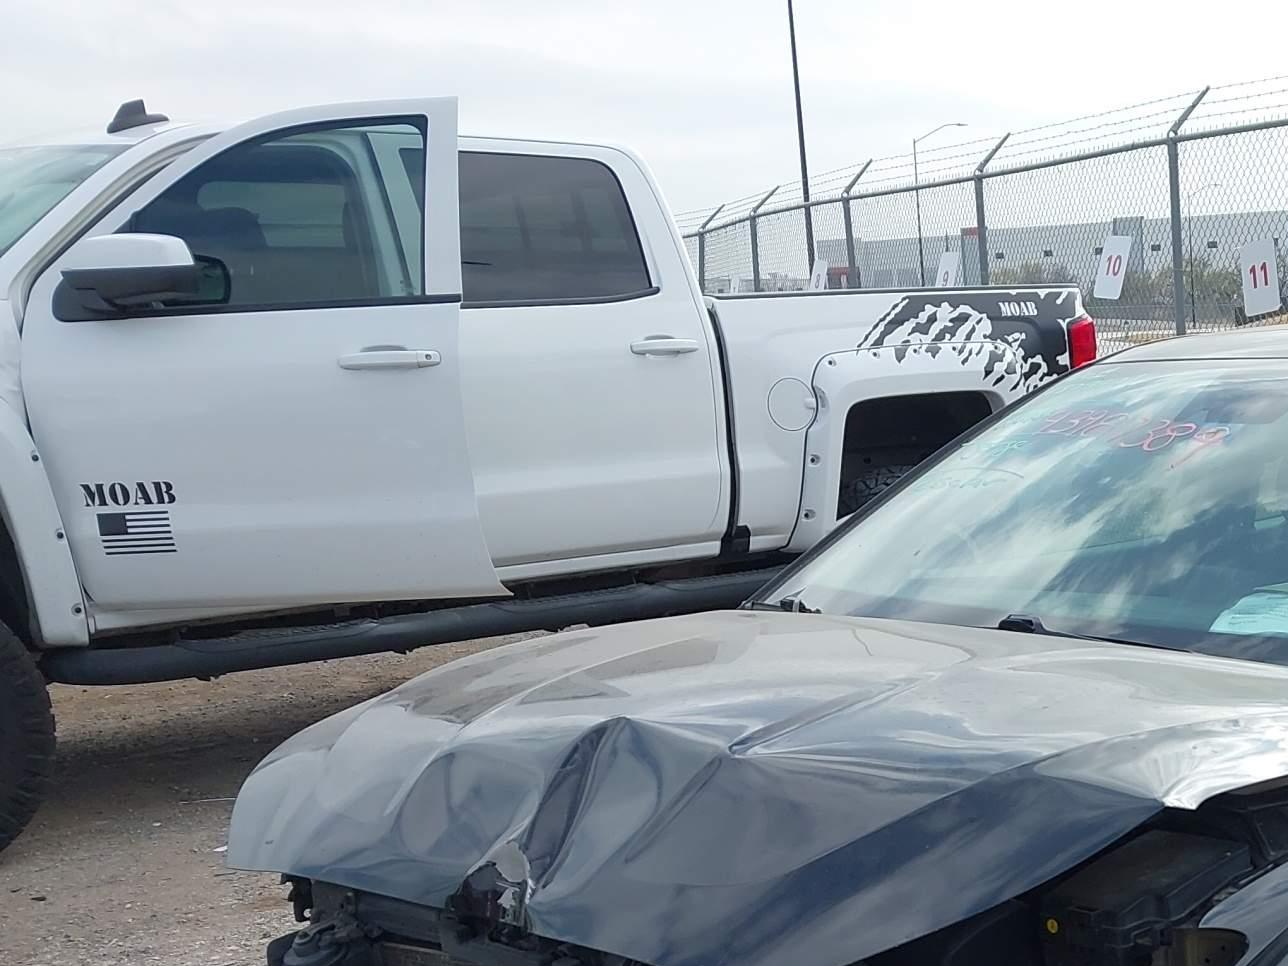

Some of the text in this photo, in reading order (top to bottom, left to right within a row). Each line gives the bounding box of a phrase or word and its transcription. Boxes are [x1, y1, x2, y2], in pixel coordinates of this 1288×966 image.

[1105, 254, 1122, 277] 10
[814, 273, 821, 289] 8
[942, 270, 949, 286] 9
[1249, 261, 1269, 290] 11
[999, 301, 1038, 317] MOAB
[79, 481, 177, 507] MOAB
